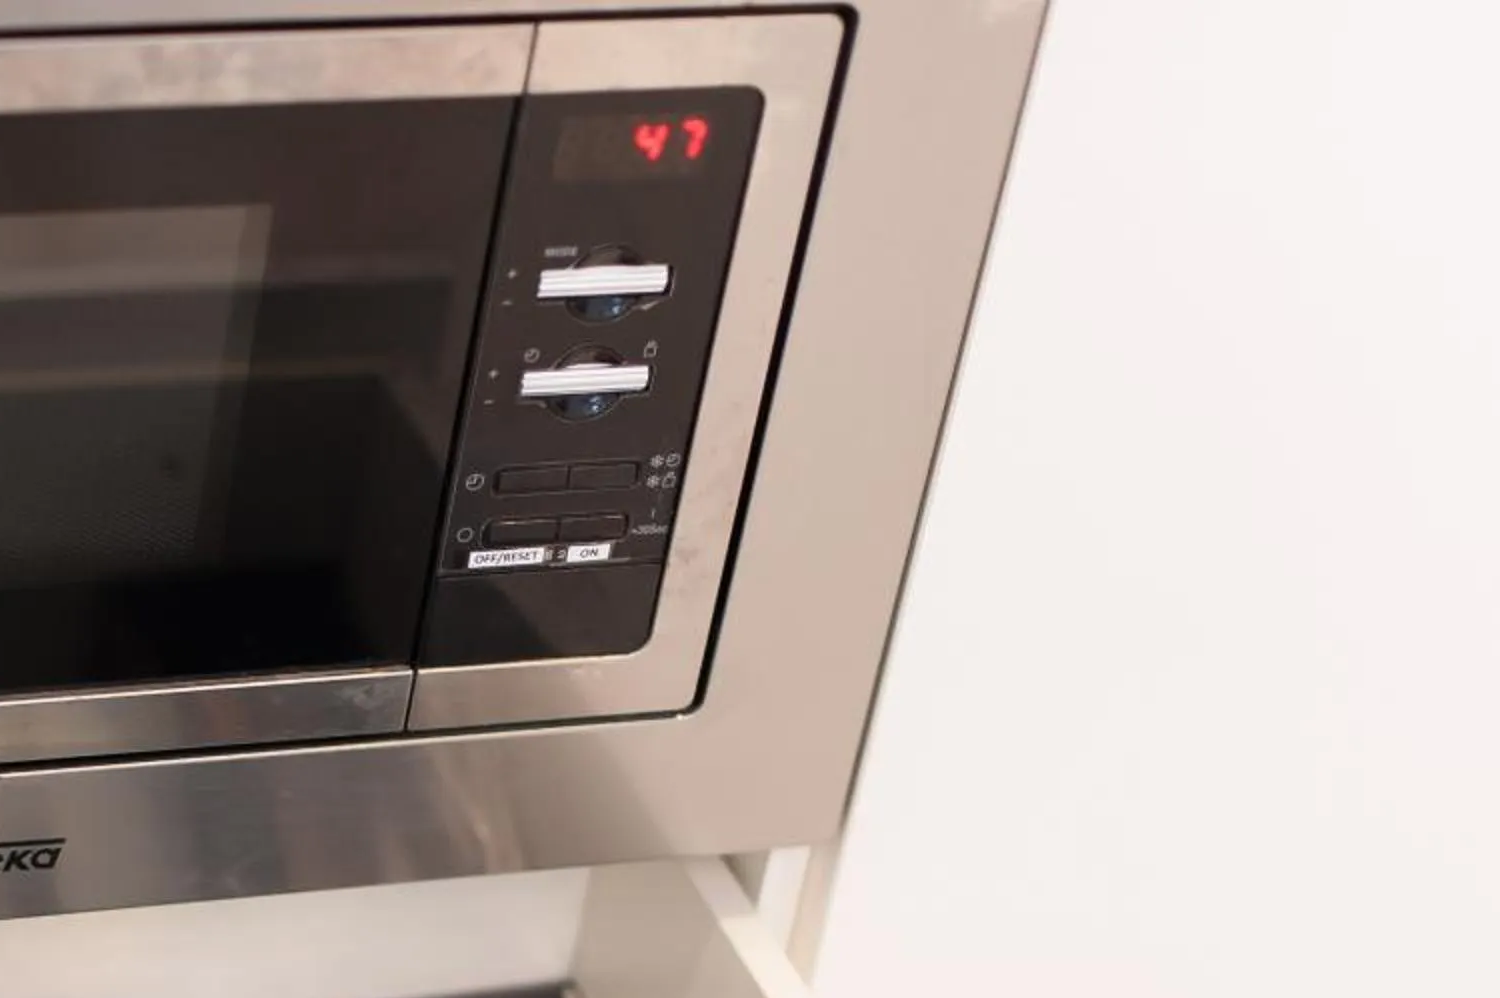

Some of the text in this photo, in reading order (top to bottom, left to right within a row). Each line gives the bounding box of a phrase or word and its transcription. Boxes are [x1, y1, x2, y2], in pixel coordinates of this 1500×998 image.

[632, 117, 708, 161] 47
[474, 551, 538, 564] OFF/RESET
[580, 548, 598, 558] ON
